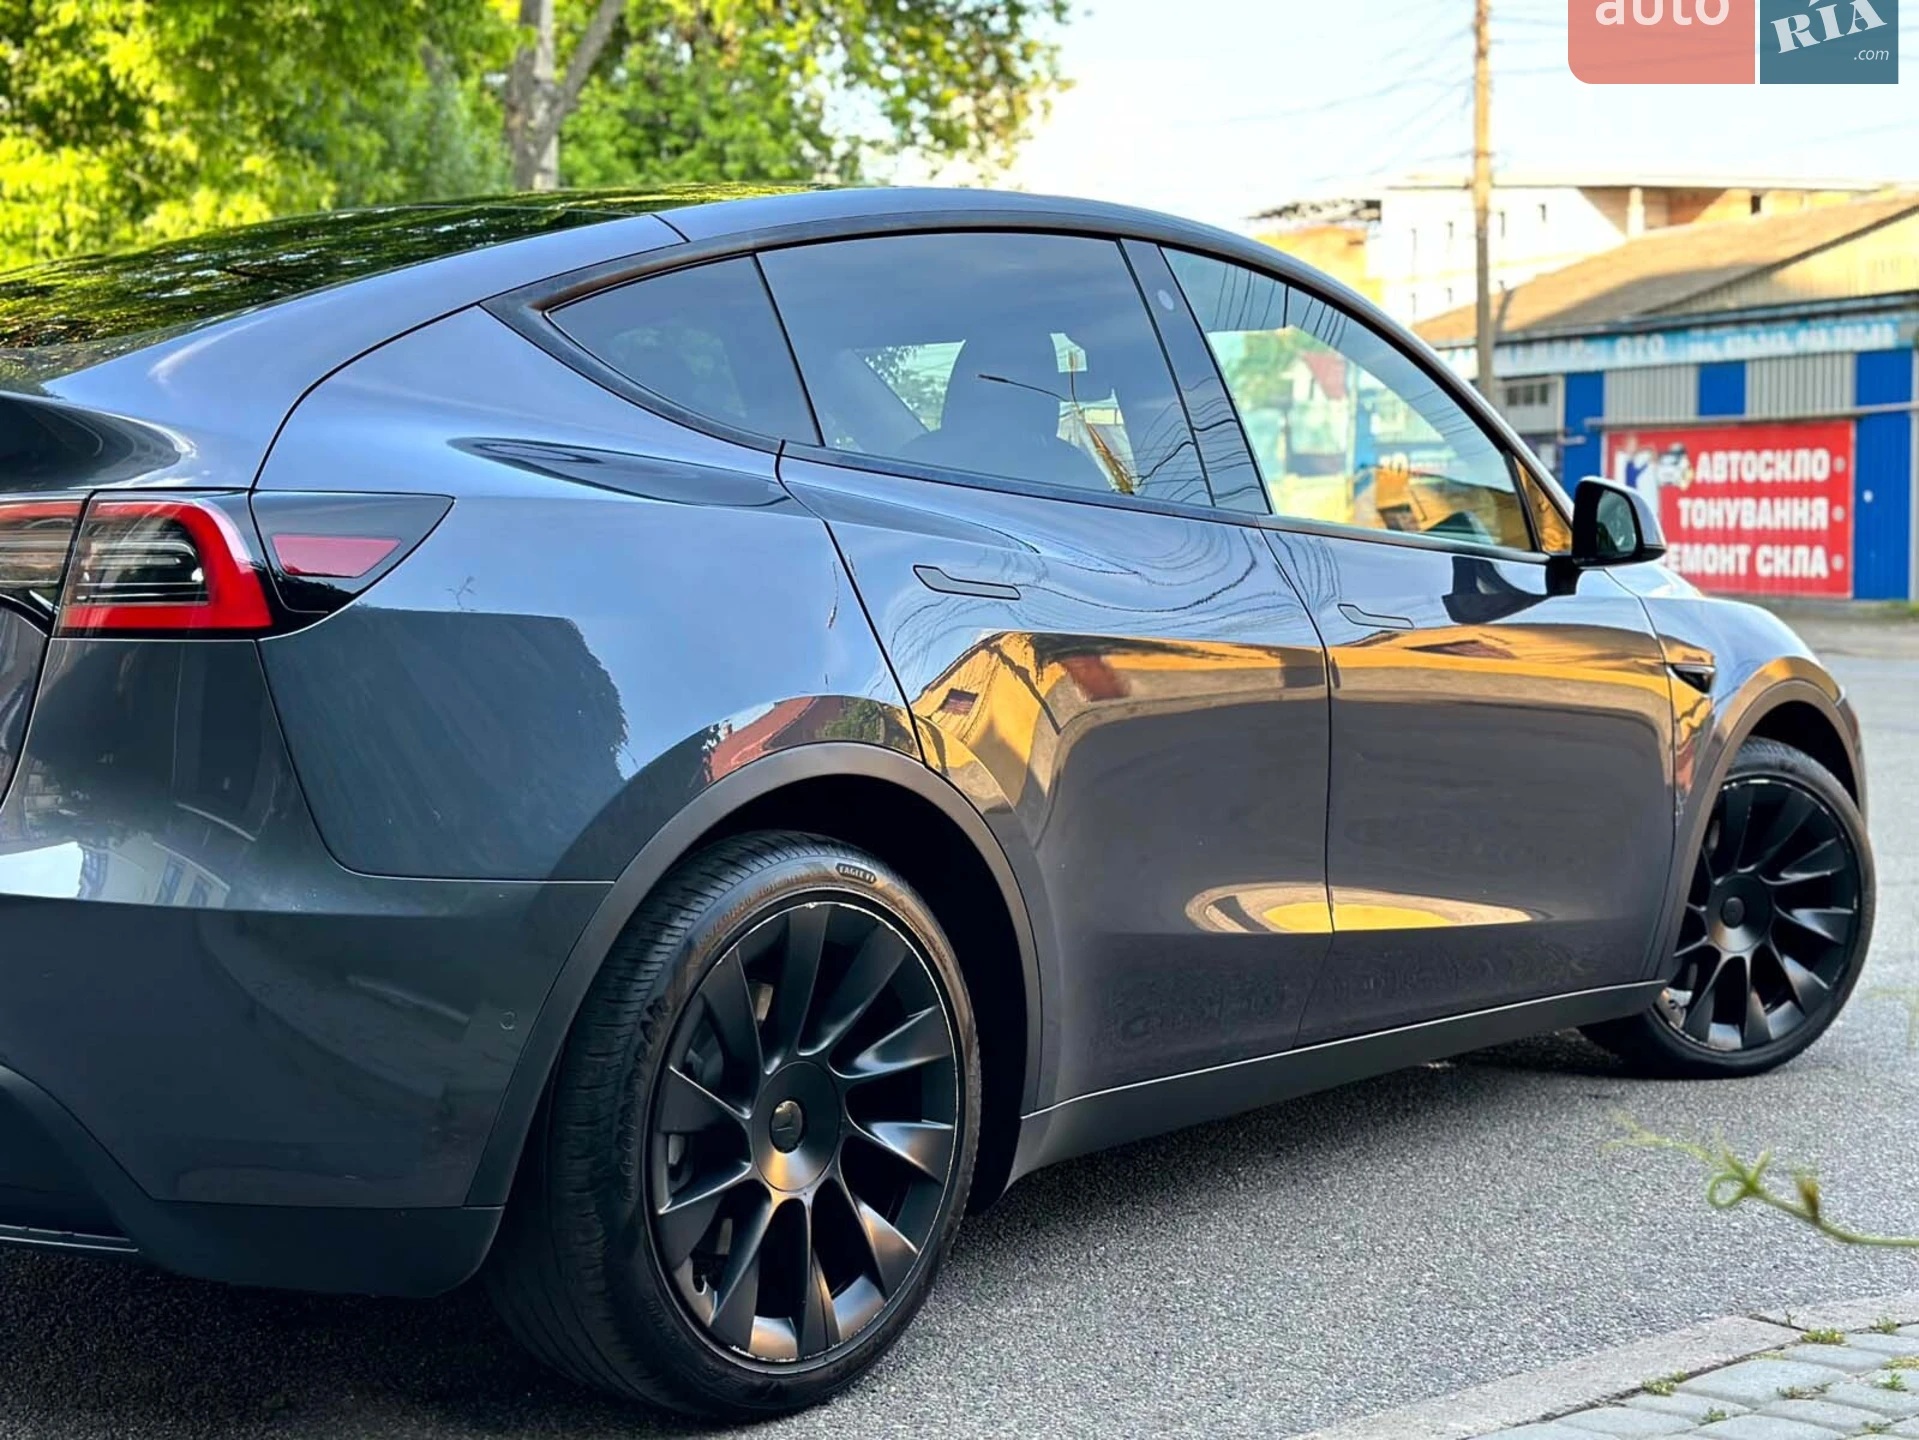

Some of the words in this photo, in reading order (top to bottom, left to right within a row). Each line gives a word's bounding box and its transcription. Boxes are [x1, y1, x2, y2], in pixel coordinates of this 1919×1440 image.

[1695, 448, 1831, 484] АВТОСКЛО
[1677, 496, 1830, 531] ТОНУВАННЯ
[1660, 543, 1750, 577] ЕМОНТ
[1755, 545, 1830, 579] СКЛА
